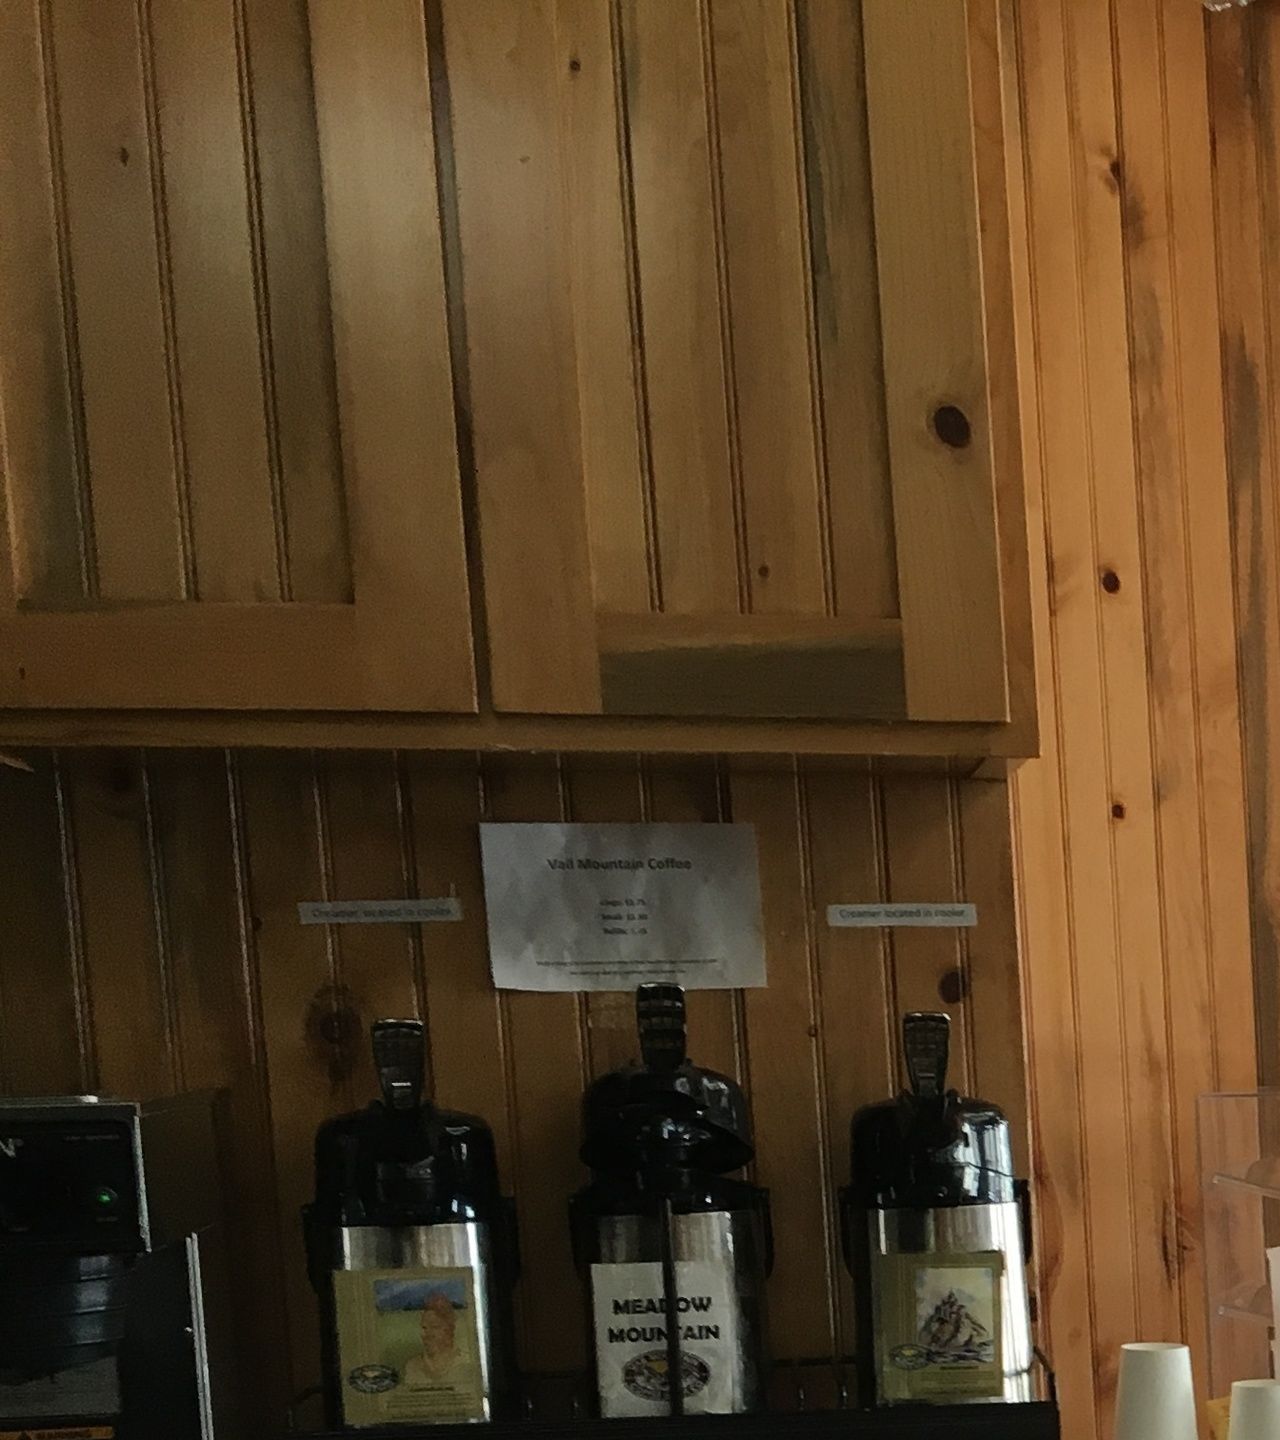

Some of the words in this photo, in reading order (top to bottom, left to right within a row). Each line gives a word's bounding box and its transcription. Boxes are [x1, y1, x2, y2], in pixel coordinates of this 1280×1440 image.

[546, 858, 575, 871] Vail
[576, 858, 645, 871] Mountain
[647, 857, 693, 871] Coffee
[607, 1324, 721, 1344] MOUNAIN
